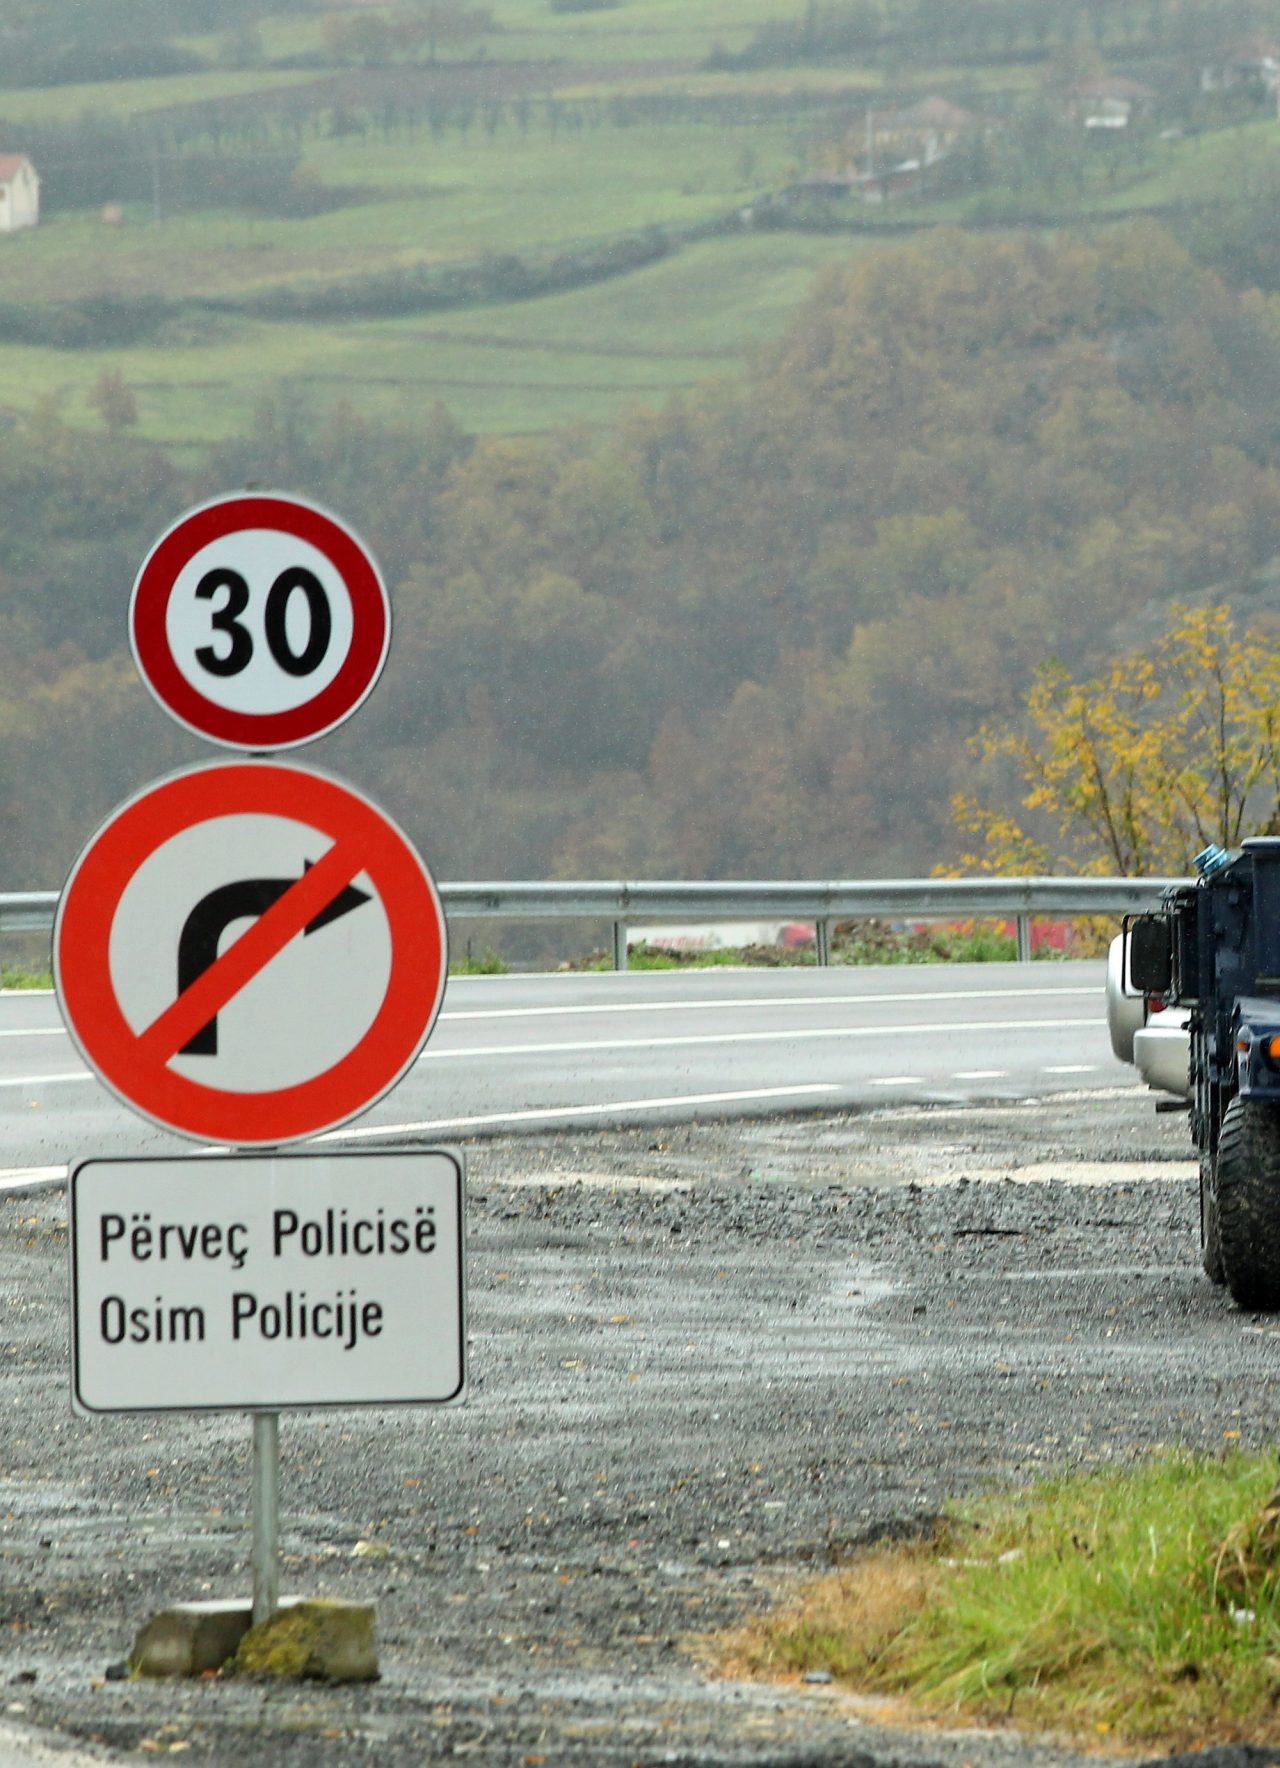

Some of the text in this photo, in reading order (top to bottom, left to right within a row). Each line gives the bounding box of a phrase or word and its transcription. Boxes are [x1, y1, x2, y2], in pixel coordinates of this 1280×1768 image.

[194, 566, 332, 678] 30
[100, 1206, 437, 1270] Përveç Policisë
[100, 1289, 384, 1350] Osim Policije
